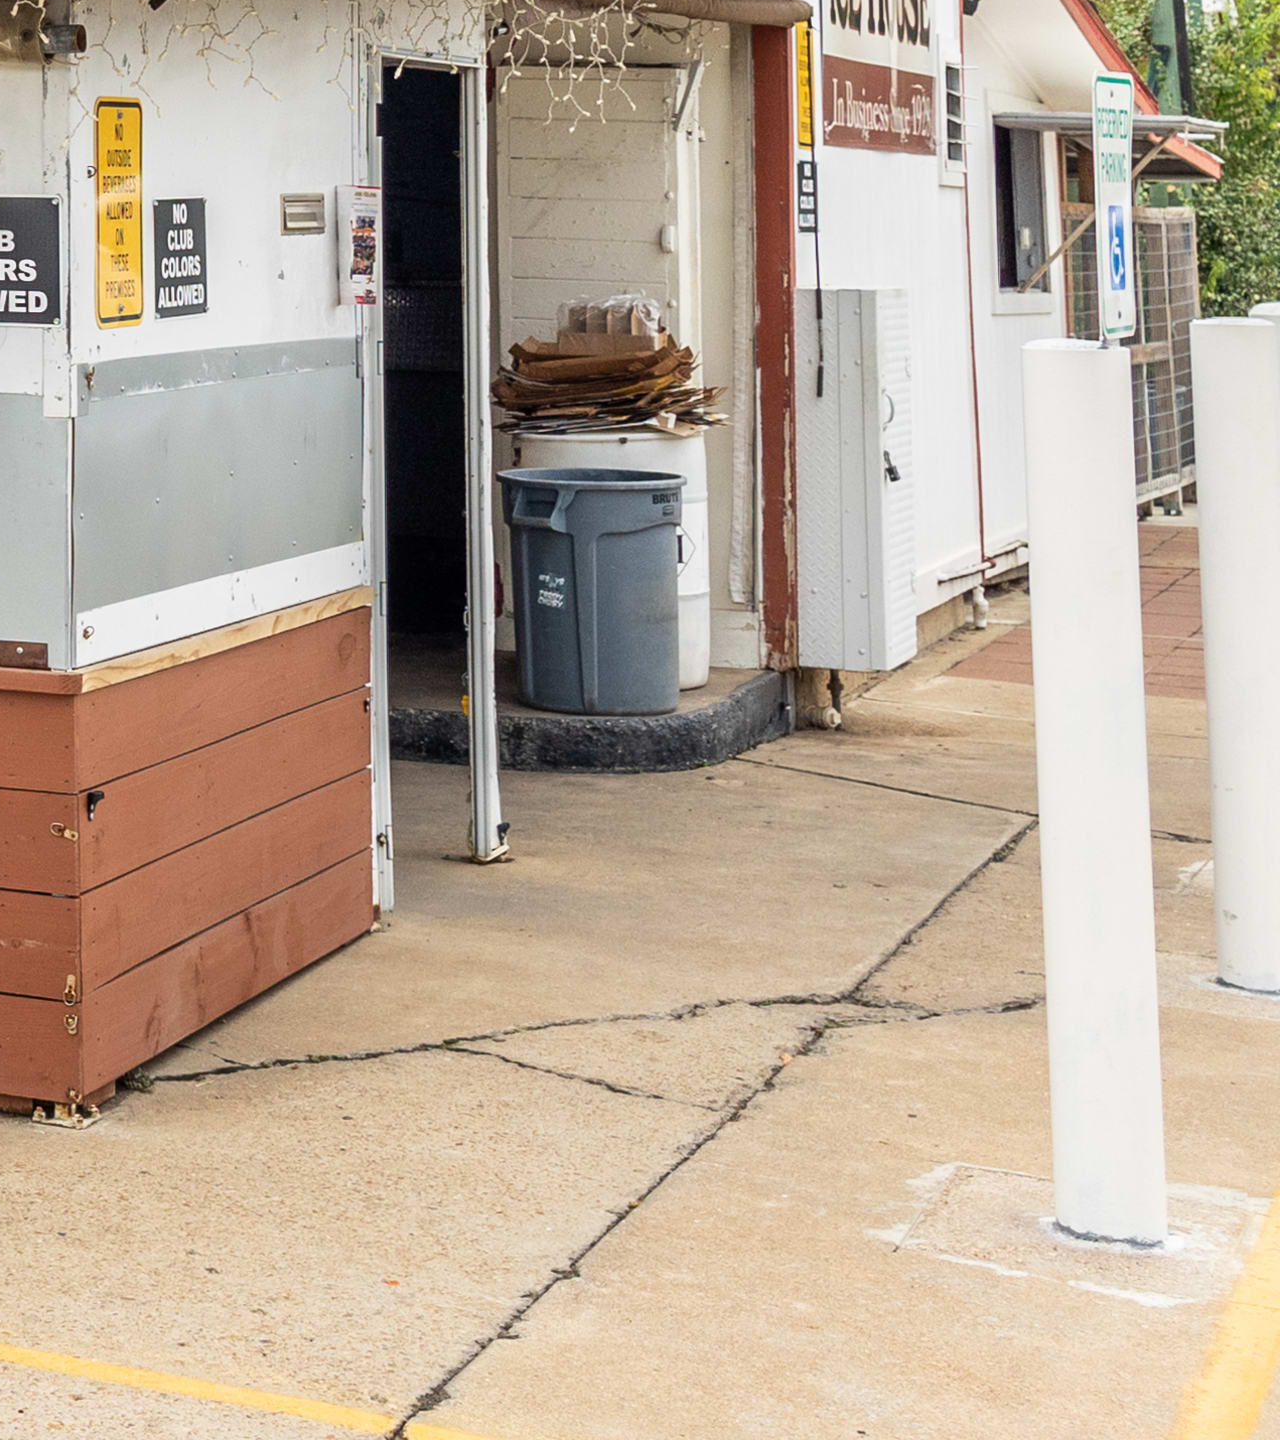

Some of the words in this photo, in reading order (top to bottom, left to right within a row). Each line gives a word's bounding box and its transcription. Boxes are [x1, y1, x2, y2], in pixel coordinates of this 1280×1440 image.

[831, 78, 845, 127] In
[845, 80, 889, 132] Business
[114, 123, 124, 141] NO
[106, 149, 132, 167] OUTSIDE
[106, 201, 134, 220] ALLOWED
[172, 203, 188, 225] NO
[115, 228, 124, 246] ON
[167, 228, 194, 252] CLUB
[161, 255, 201, 279] COLORS
[157, 284, 205, 309] ALLOWED
